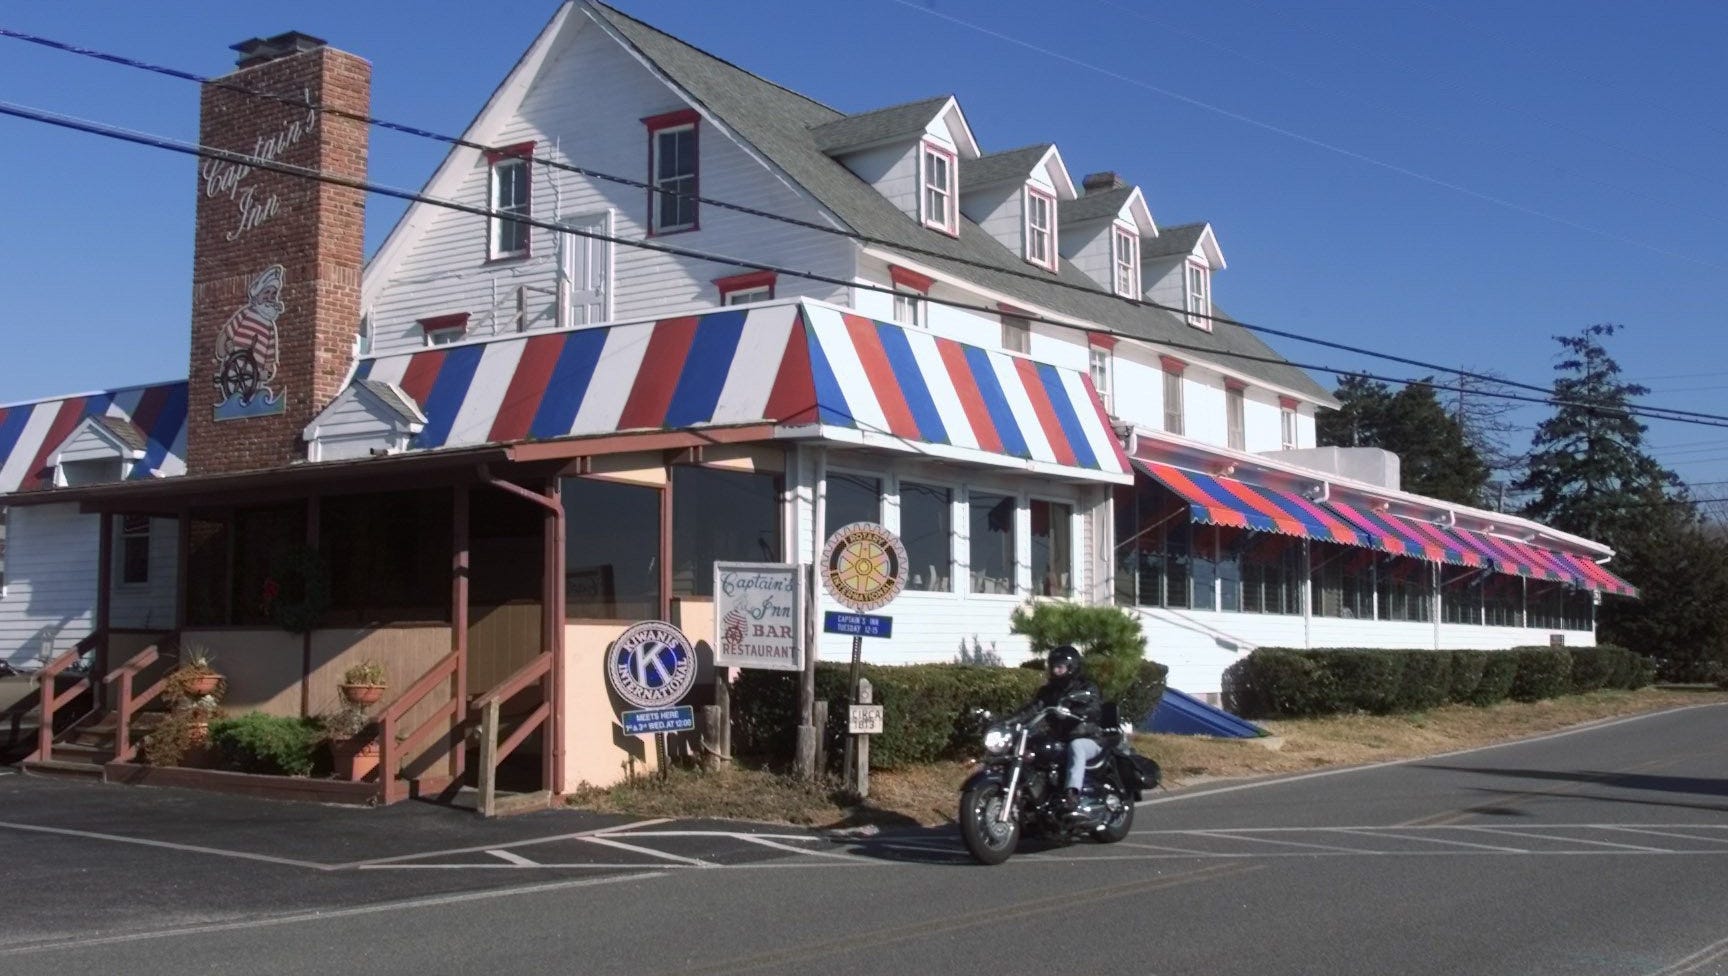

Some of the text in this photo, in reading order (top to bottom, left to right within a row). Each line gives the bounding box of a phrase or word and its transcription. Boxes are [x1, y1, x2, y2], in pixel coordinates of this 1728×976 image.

[226, 184, 280, 241] Inn
[848, 532, 886, 549] ROTARY
[720, 572, 794, 597] Captain's
[748, 595, 791, 620] Inn
[623, 630, 678, 652] KIWANIS
[752, 624, 794, 639] BAR
[722, 643, 799, 659] RESTAURANT
[635, 642, 674, 687] K
[618, 657, 688, 699] INTERNATIONAL
[636, 710, 679, 722] MEETS HERE
[852, 710, 881, 720] CIRCA
